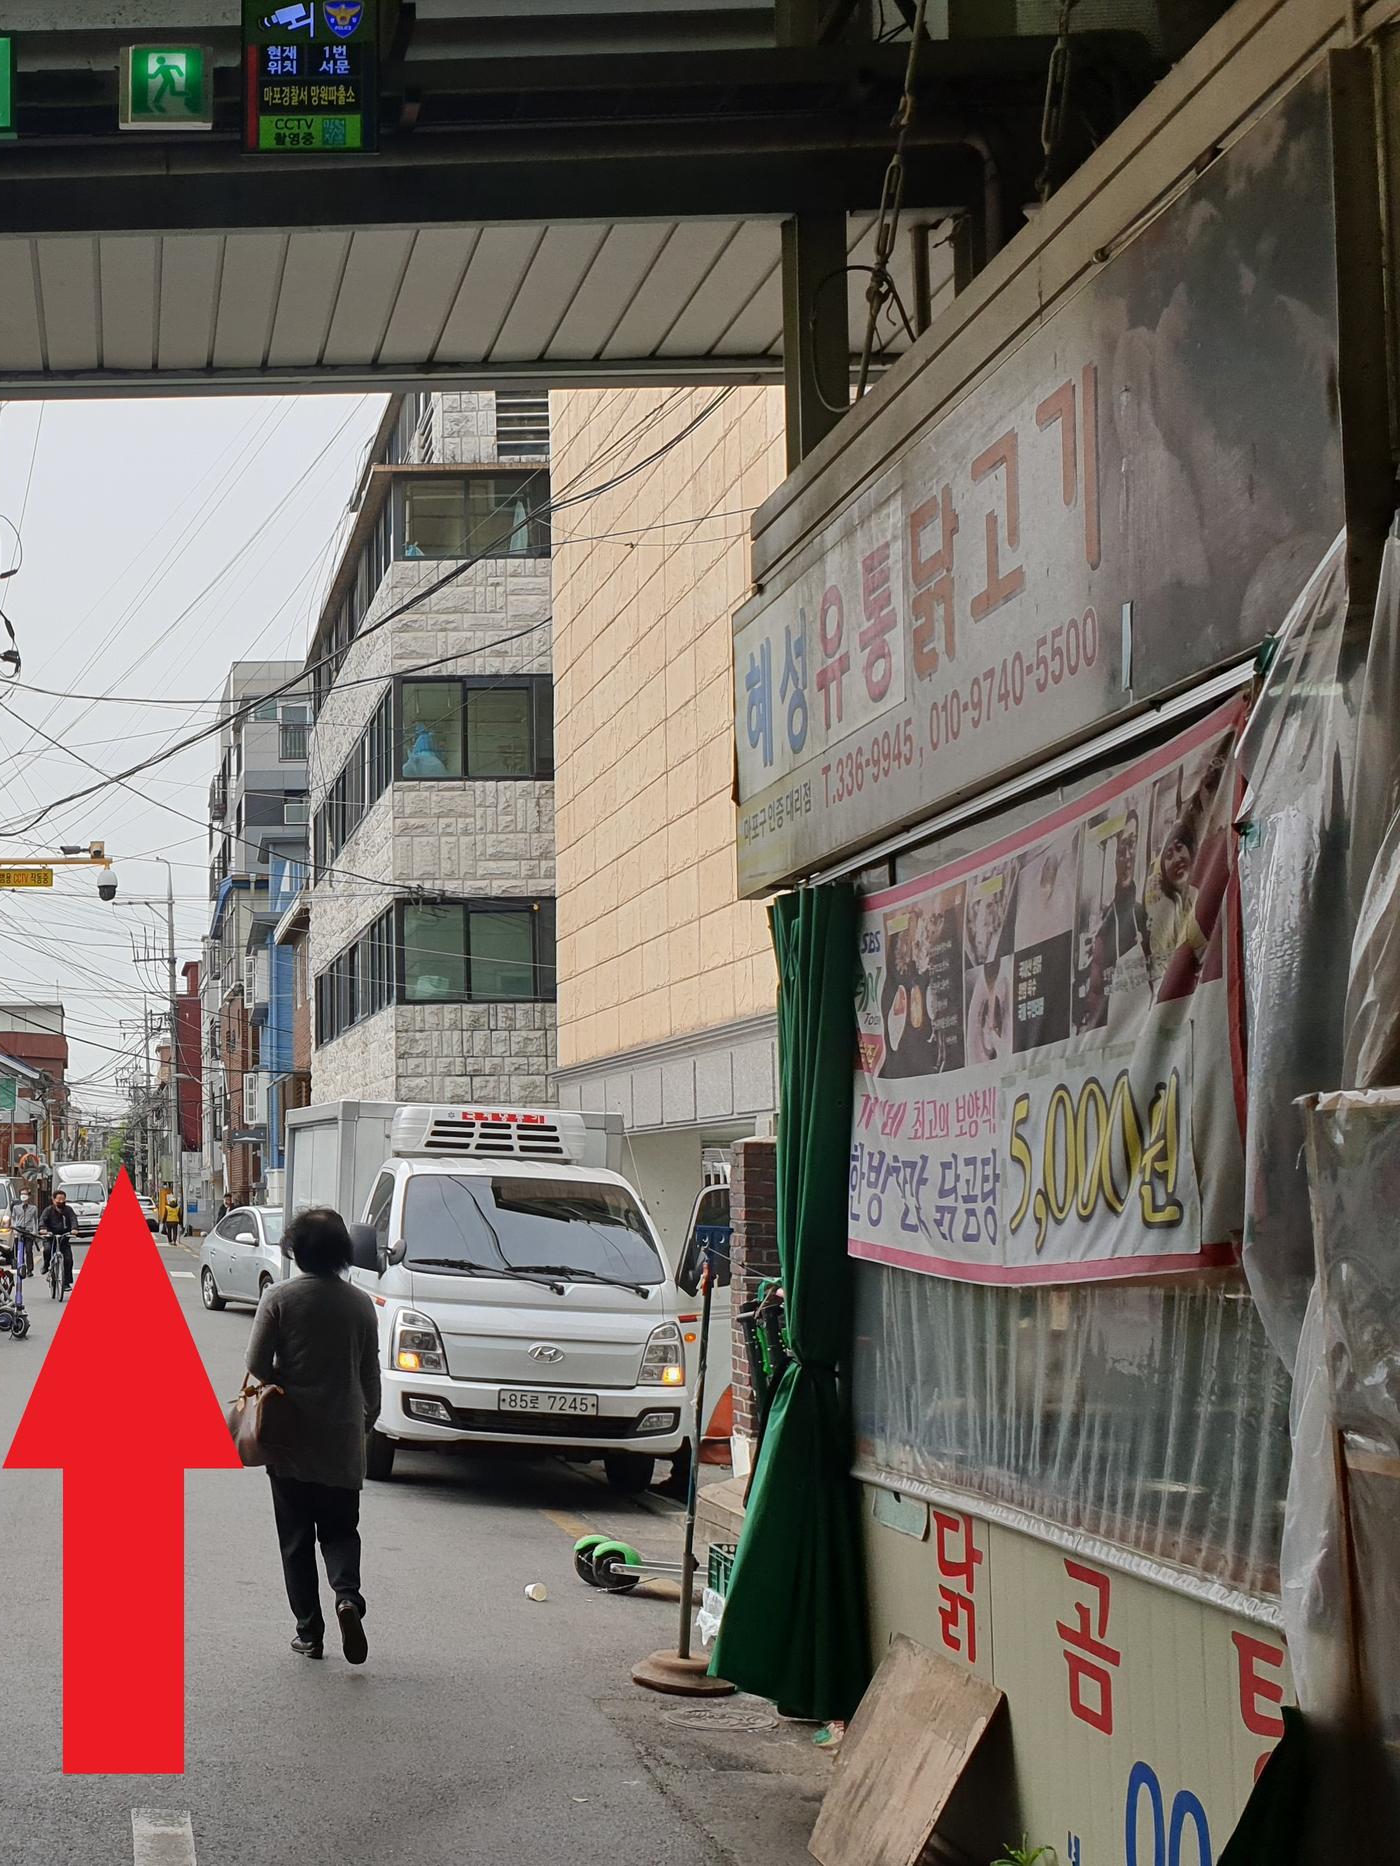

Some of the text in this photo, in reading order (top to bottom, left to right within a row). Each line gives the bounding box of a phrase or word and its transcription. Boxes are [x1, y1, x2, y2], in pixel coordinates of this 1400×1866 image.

[267, 45, 297, 60] 현재
[323, 45, 347, 59] 1번
[267, 60, 297, 75] 위치
[319, 60, 350, 75] 서문
[263, 84, 356, 107] 마포경찰서 망원파출소
[274, 118, 314, 131] CCTV
[909, 361, 1103, 682] 닭고기
[929, 606, 1099, 752] 010-9740-5500
[908, 1099, 950, 1140] 최고의
[1009, 1065, 1184, 1255] 5,000원
[508, 1393, 588, 1413] 85로 7245
